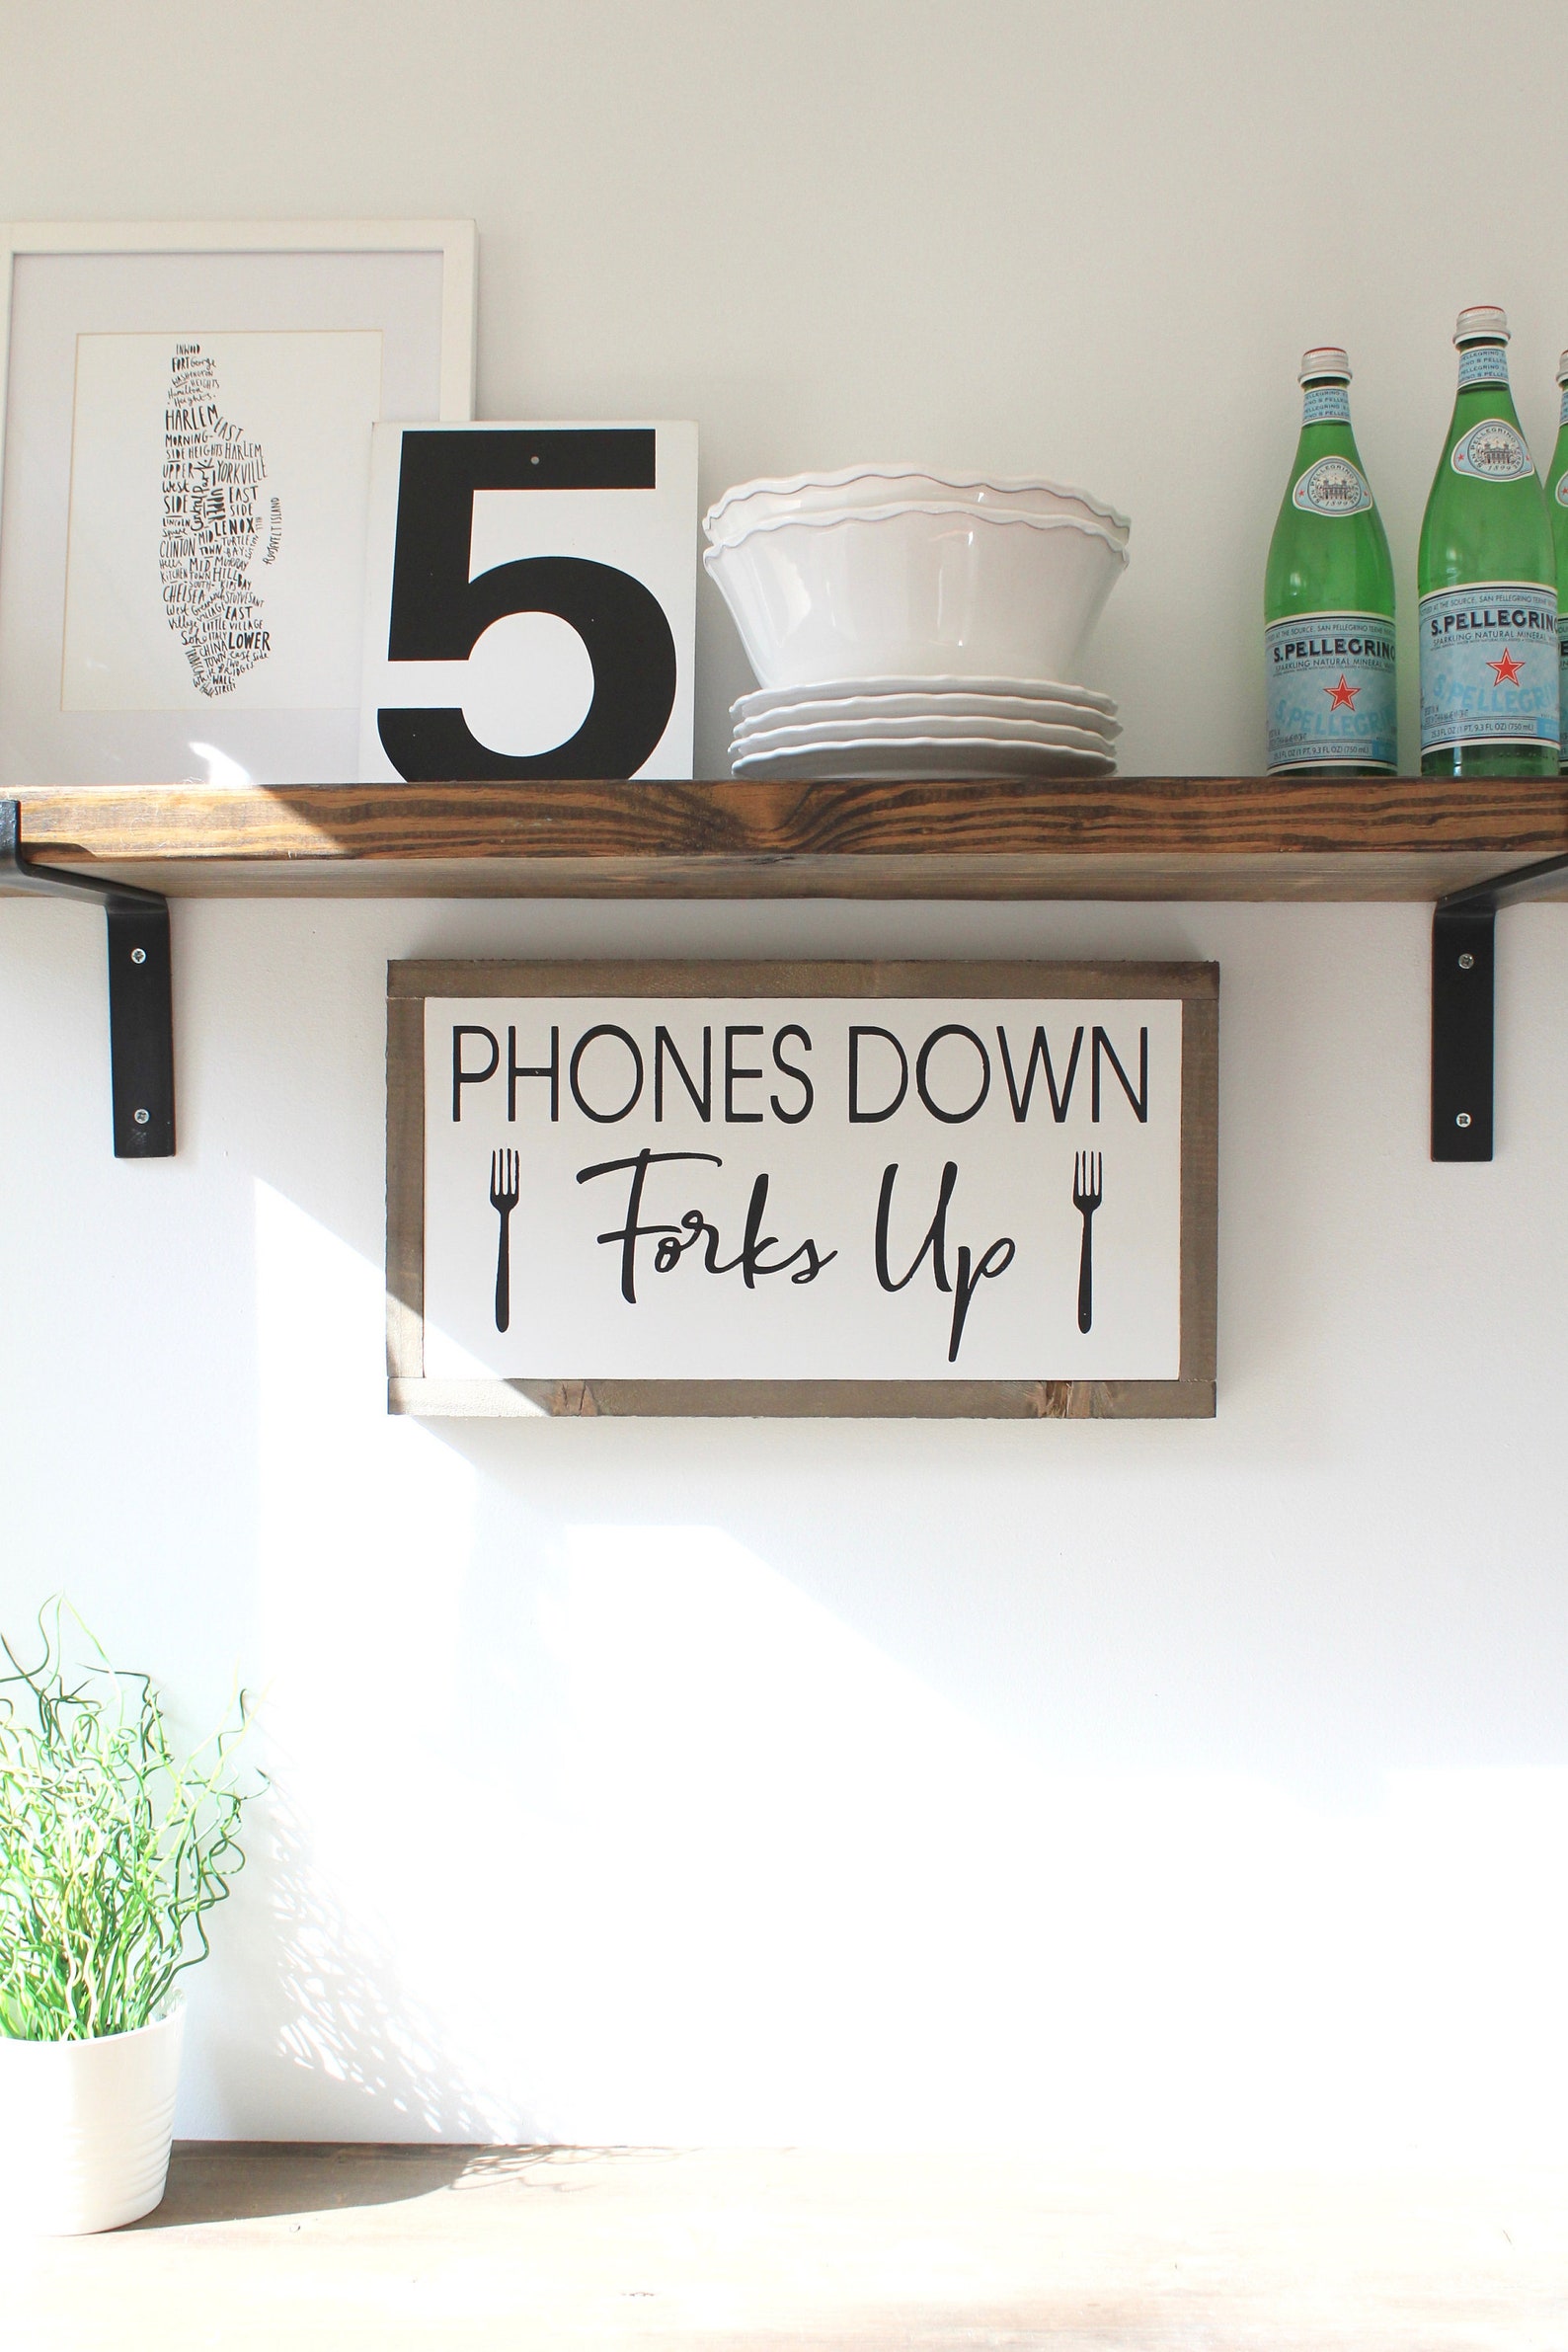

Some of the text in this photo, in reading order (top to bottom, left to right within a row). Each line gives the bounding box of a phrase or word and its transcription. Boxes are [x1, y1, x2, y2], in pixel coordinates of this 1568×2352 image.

[172, 356, 217, 373] FORT George
[191, 379, 220, 390] HEIGHTS
[165, 404, 218, 431] HARLEM
[213, 416, 244, 441] EAST
[1470, 427, 1517, 450] PELLEGRINO
[166, 443, 223, 460] SIDE HEIGHTS
[224, 440, 264, 460] HARLEM
[163, 462, 195, 480] UPPER
[217, 457, 268, 485] YORKVILLE
[162, 479, 191, 494] West
[229, 485, 259, 504] EAST
[163, 494, 188, 514] SIDE
[229, 503, 253, 516] SIDE
[162, 517, 191, 527] LINCOLN
[214, 517, 255, 536] LENOX
[159, 537, 196, 558] CLINTON
[221, 534, 249, 547] TURTLE
[199, 544, 222, 556] TOWN
[189, 557, 211, 572] MID
[214, 555, 249, 572] MURRAY
[189, 571, 211, 581] TOWN
[212, 567, 238, 582] HILL
[237, 573, 252, 590] BAY
[163, 583, 204, 604] CHELSEA
[224, 591, 266, 608] STUYVESANT
[1495, 594, 1531, 603] PELLEGRINO
[166, 603, 189, 616] West
[225, 605, 253, 621] EAST
[377, 429, 676, 782] 5
[202, 617, 226, 633] LITTLE
[229, 618, 264, 631] VILLAGE
[207, 631, 227, 642] ITALY
[228, 631, 271, 652] LOWER
[1433, 632, 1471, 646] SPARKLING
[1474, 630, 1515, 639] NATURAL
[1517, 631, 1546, 641] MINERAL
[199, 640, 228, 658] CHINA
[1273, 638, 1395, 663] S.PELLEGRINO
[203, 652, 226, 668] TOWN
[1275, 660, 1310, 672] SPARKLING
[1312, 658, 1350, 666] NATURAL
[1353, 659, 1381, 667] MINERAL
[1474, 723, 1484, 732] 9.3
[1508, 722, 1522, 732] (750
[453, 1025, 1147, 1124] PHONES DOWN
[577, 1148, 1015, 1362] Forks Up
